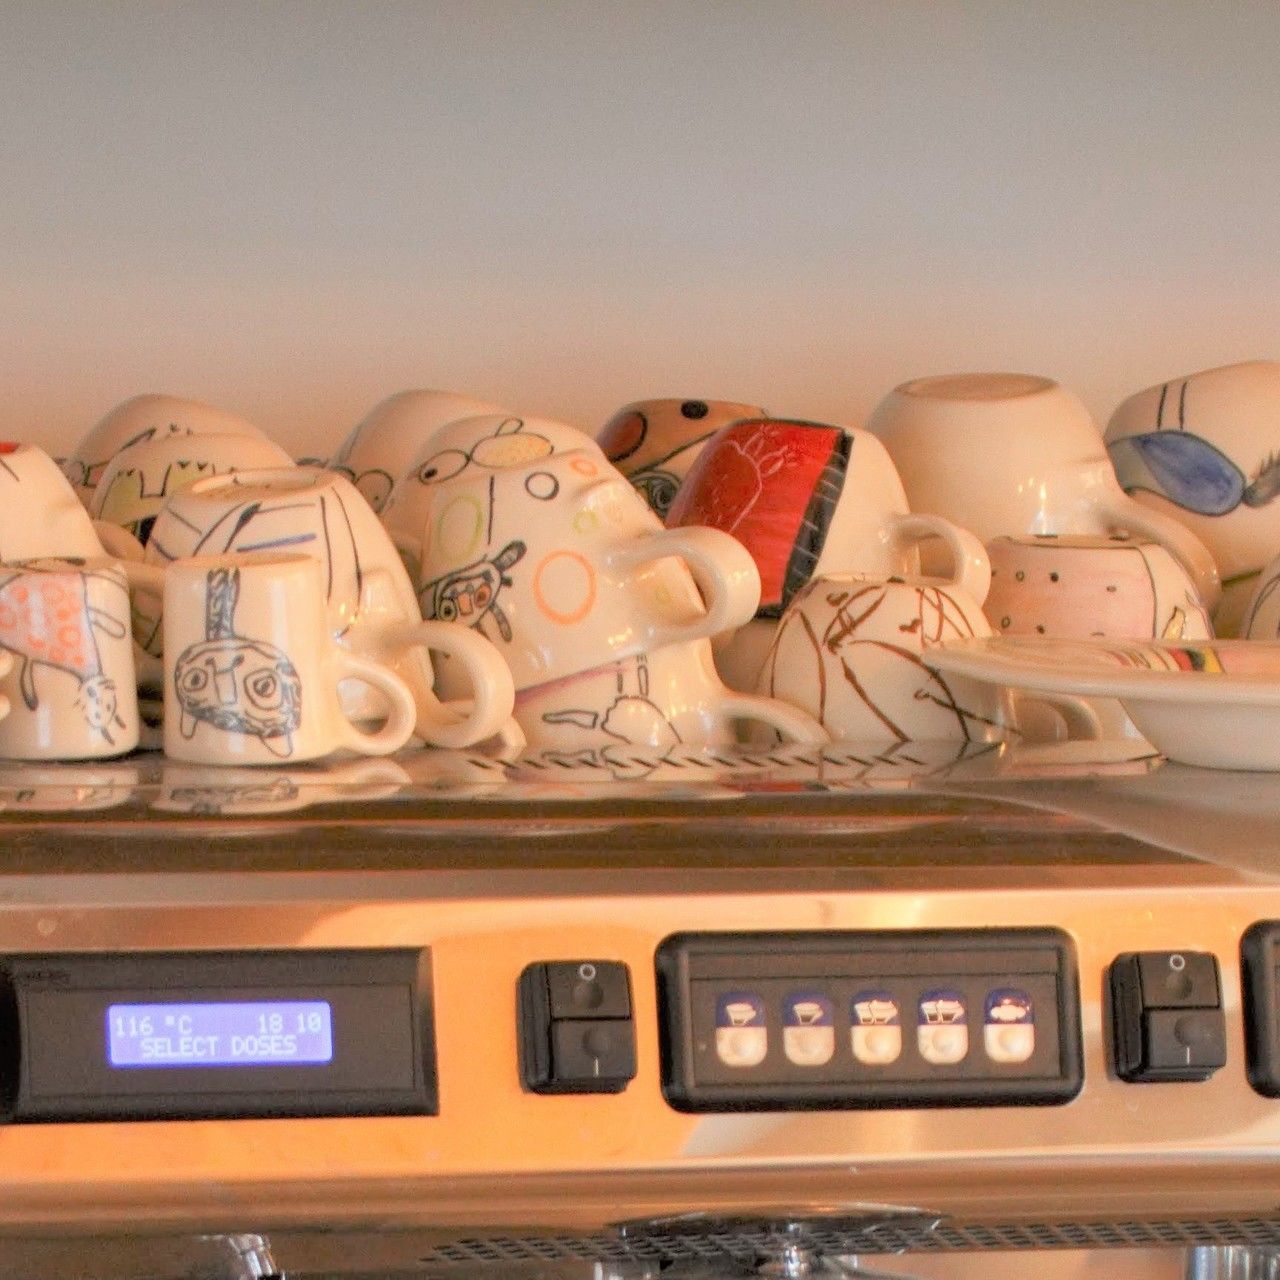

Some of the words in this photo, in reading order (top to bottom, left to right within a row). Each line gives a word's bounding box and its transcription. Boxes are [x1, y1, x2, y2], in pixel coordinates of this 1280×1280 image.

[115, 1015, 154, 1037] 116
[296, 1011, 323, 1034] 10
[140, 1036, 219, 1058] SELECT
[231, 1034, 298, 1056] DOSES
